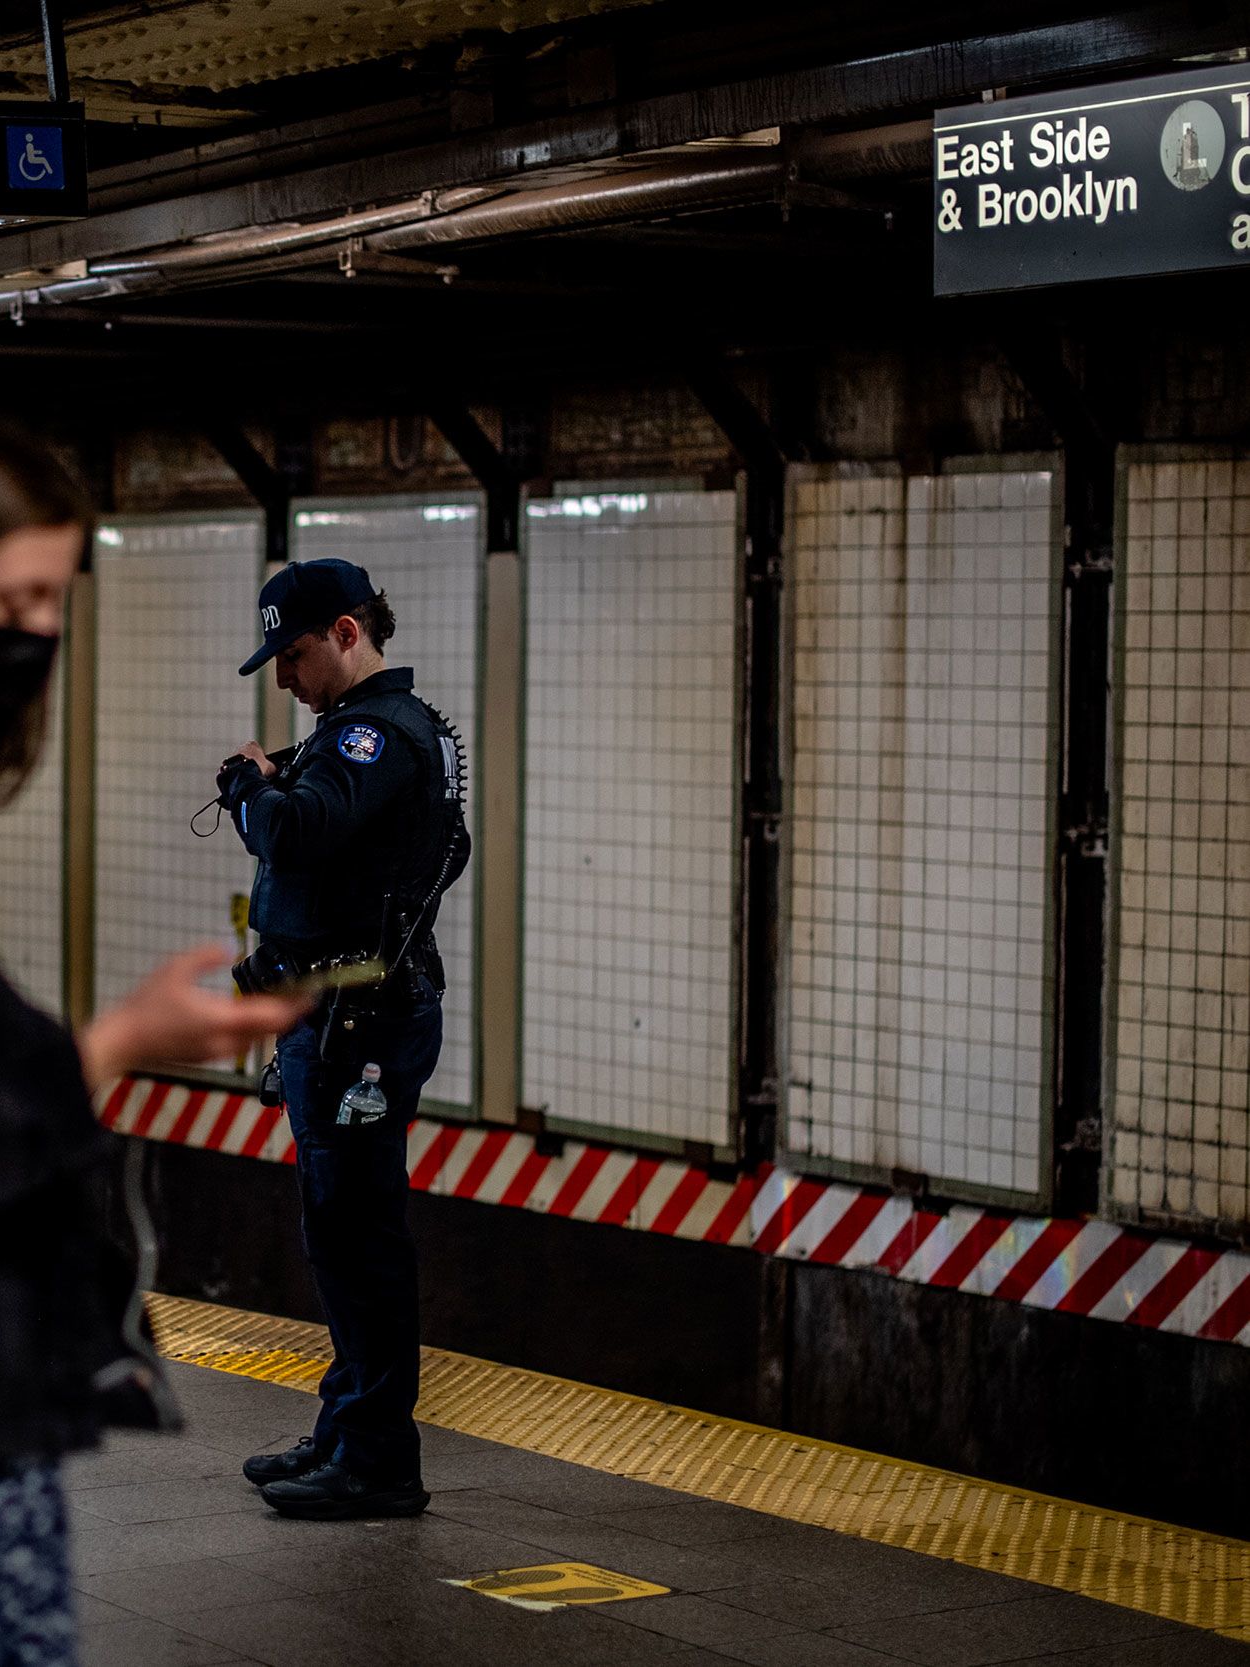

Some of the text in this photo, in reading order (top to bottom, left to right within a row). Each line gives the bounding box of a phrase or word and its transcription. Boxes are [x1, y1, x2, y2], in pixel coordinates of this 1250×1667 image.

[936, 116, 1111, 180] East Side
[937, 170, 1138, 233] & Brooklyn
[354, 726, 378, 739] NYPD
